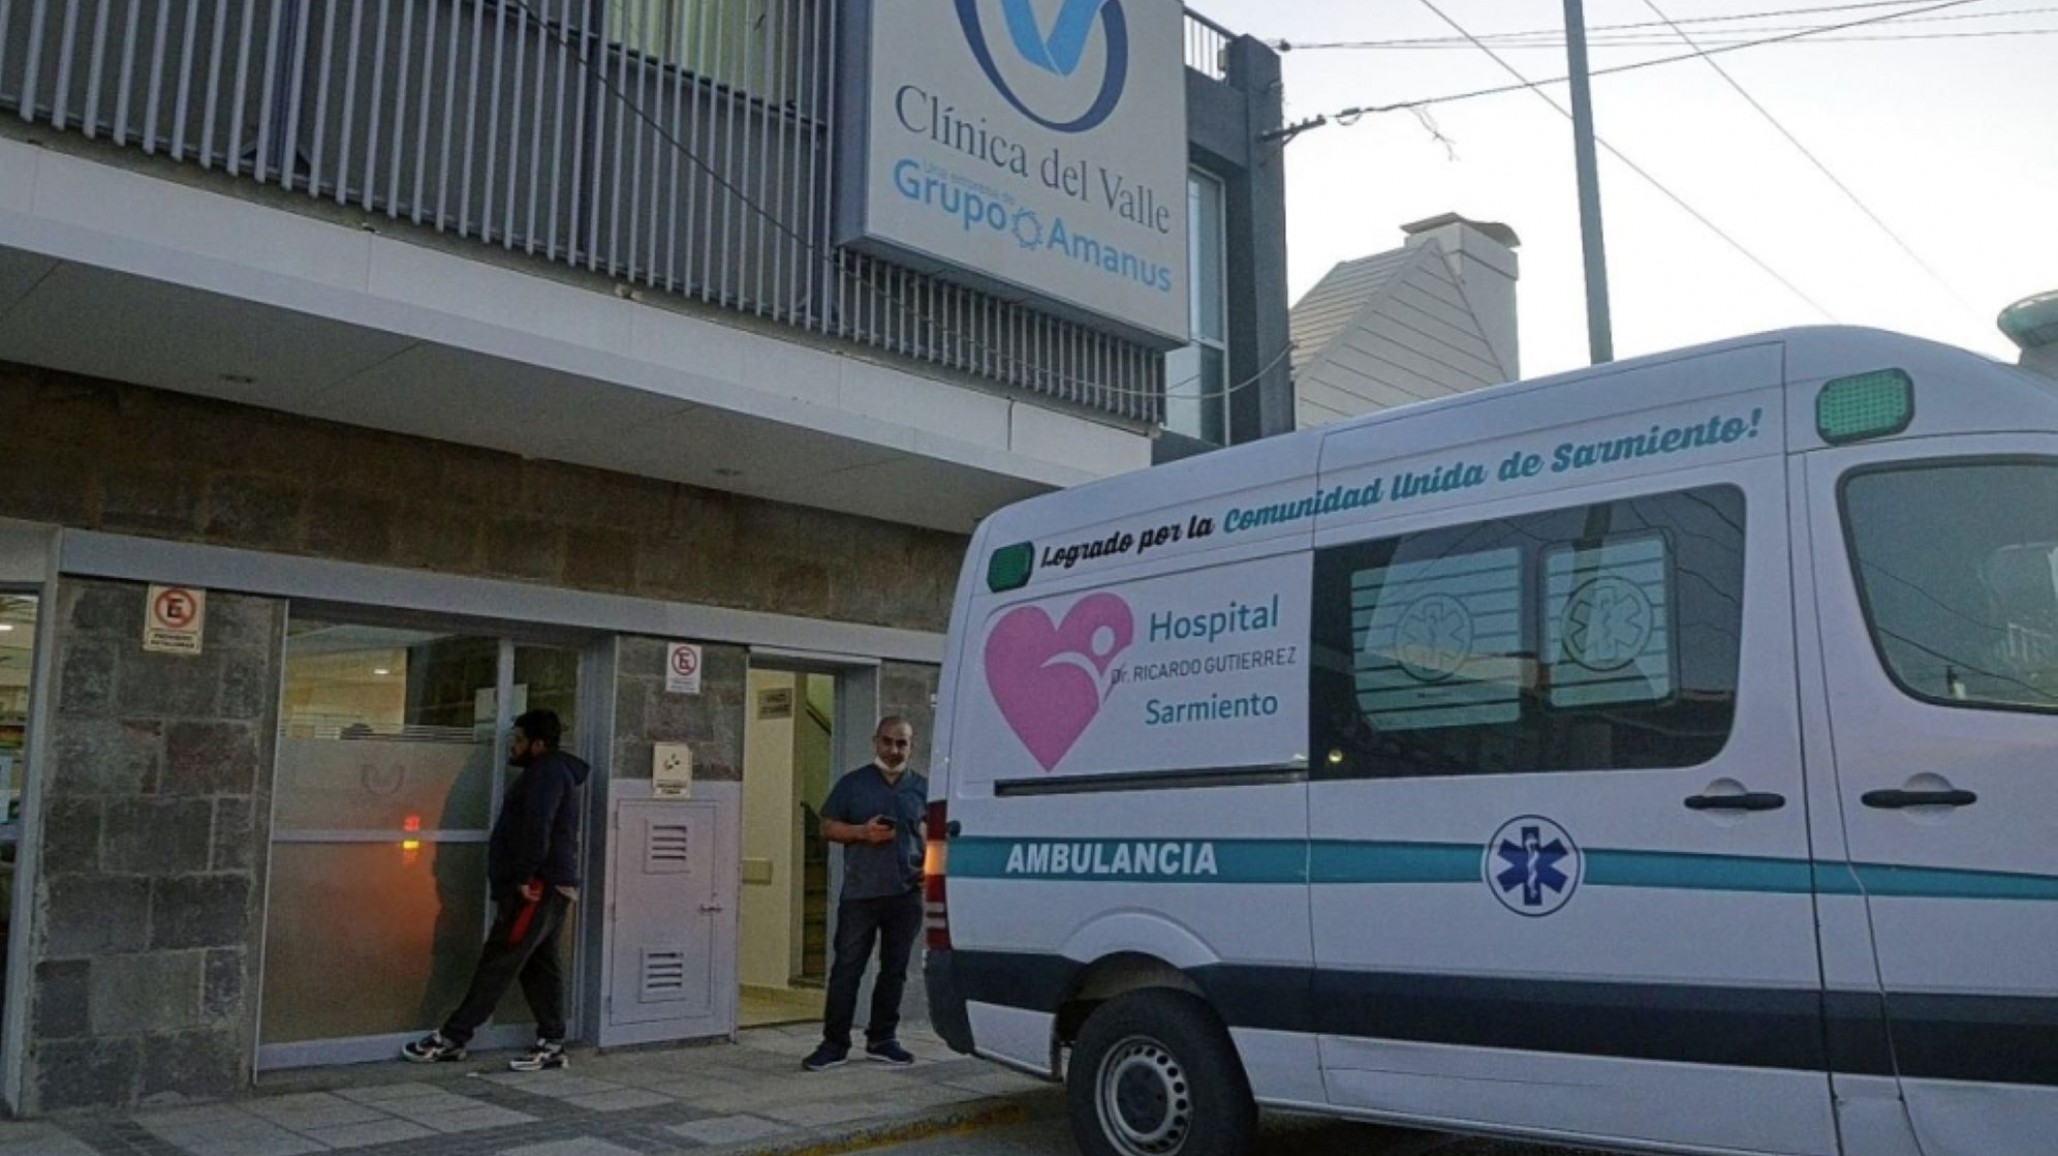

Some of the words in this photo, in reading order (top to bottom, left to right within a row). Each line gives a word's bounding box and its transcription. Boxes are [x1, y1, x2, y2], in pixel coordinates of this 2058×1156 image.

[895, 84, 1029, 178] Clínica
[1040, 148, 1088, 201] del
[1099, 167, 1171, 234] Valle
[893, 158, 1007, 231] Grupo
[1047, 217, 1172, 292] Amanus
[1040, 530, 1134, 569] Logrado
[1138, 523, 1182, 554] por
[1187, 515, 1215, 539] la
[1223, 477, 1384, 534] Comunidad
[1390, 461, 1486, 501] Unida
[1497, 450, 1544, 483] de
[1550, 407, 1763, 474] Sarmiento!
[1149, 594, 1279, 643] Hospital
[1133, 659, 1201, 682] RICARDO
[1204, 646, 1297, 674] GUTIERREZ
[1145, 692, 1279, 726] Sarmiento
[1005, 842, 1219, 876] AMBULANCIA
